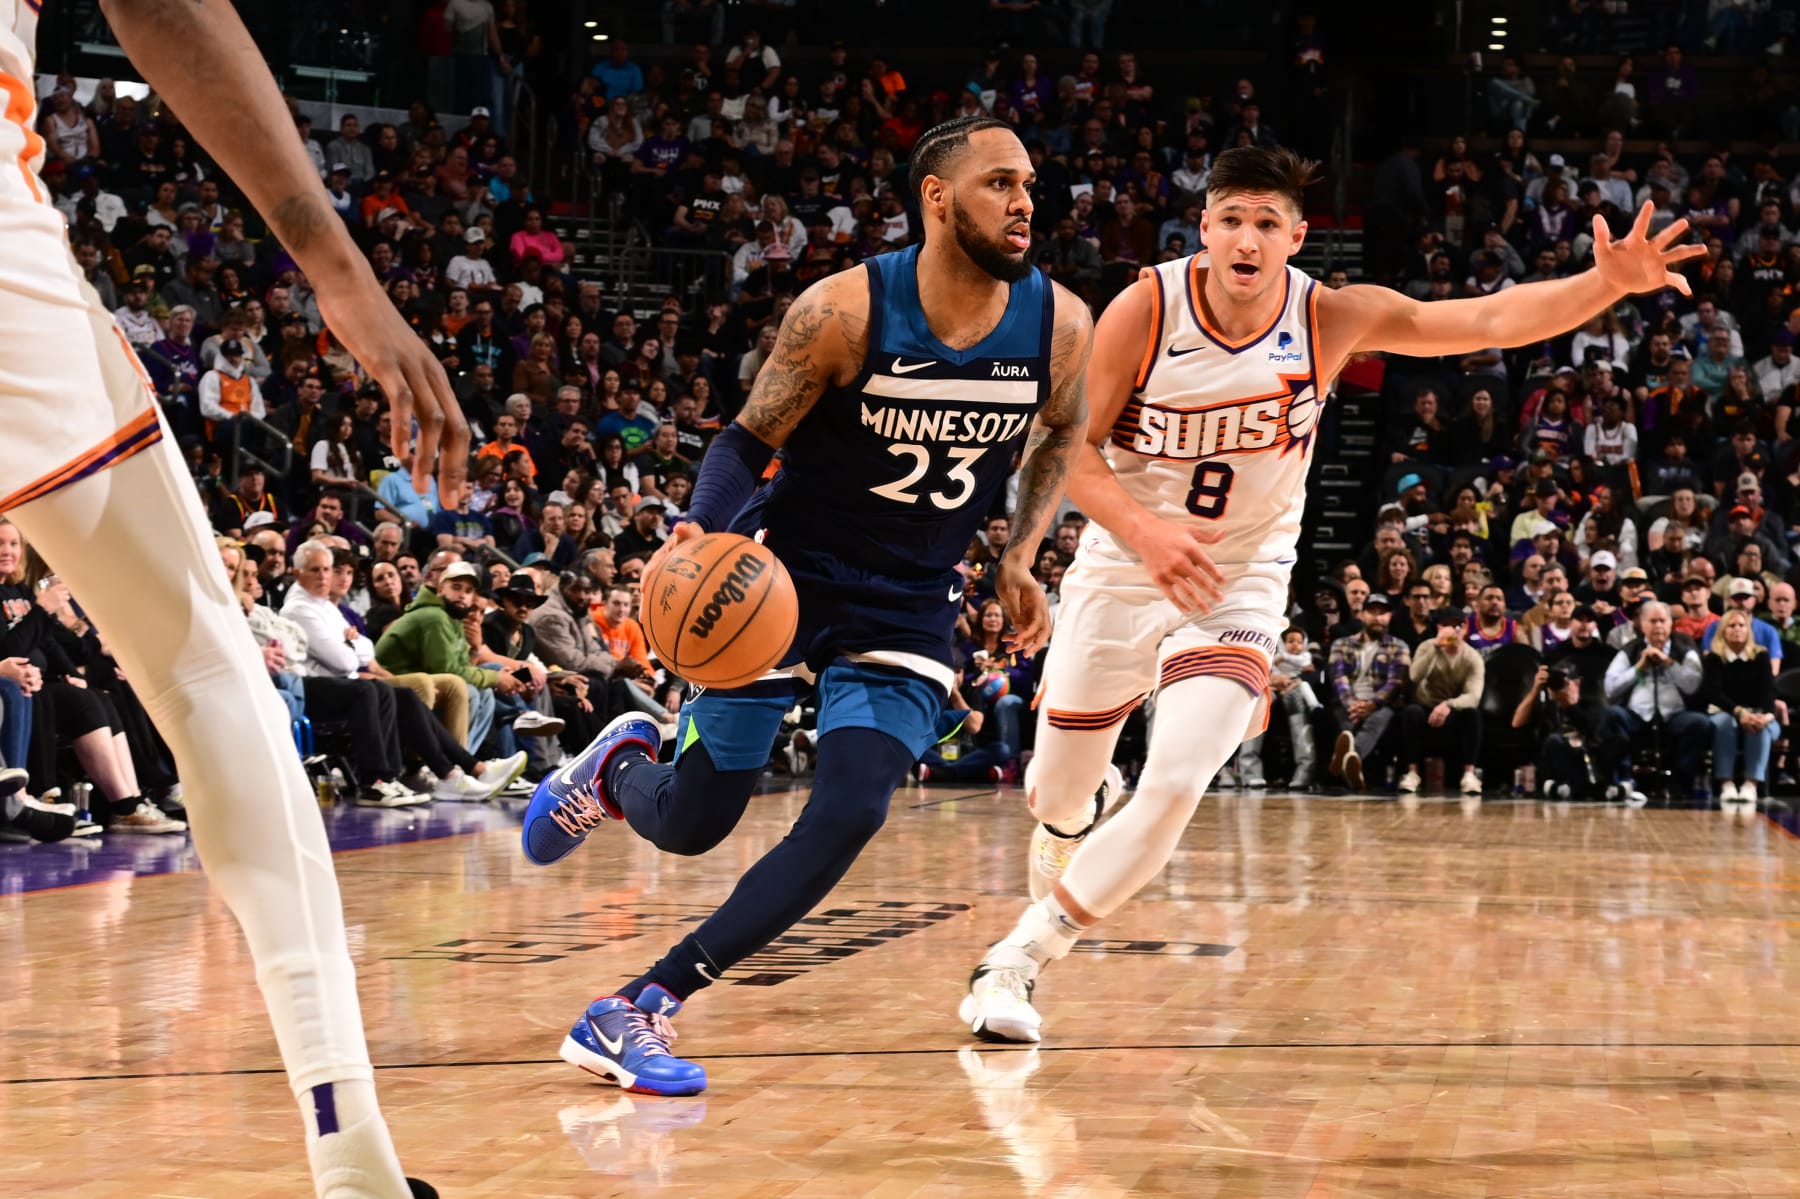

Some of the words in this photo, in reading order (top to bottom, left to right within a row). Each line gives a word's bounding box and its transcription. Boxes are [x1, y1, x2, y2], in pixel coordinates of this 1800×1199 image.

[692, 198, 721, 211] PHX
[1268, 352, 1303, 362] PayPal
[868, 442, 990, 510] 23
[1185, 460, 1235, 520] 8
[688, 552, 767, 640] Wilson
